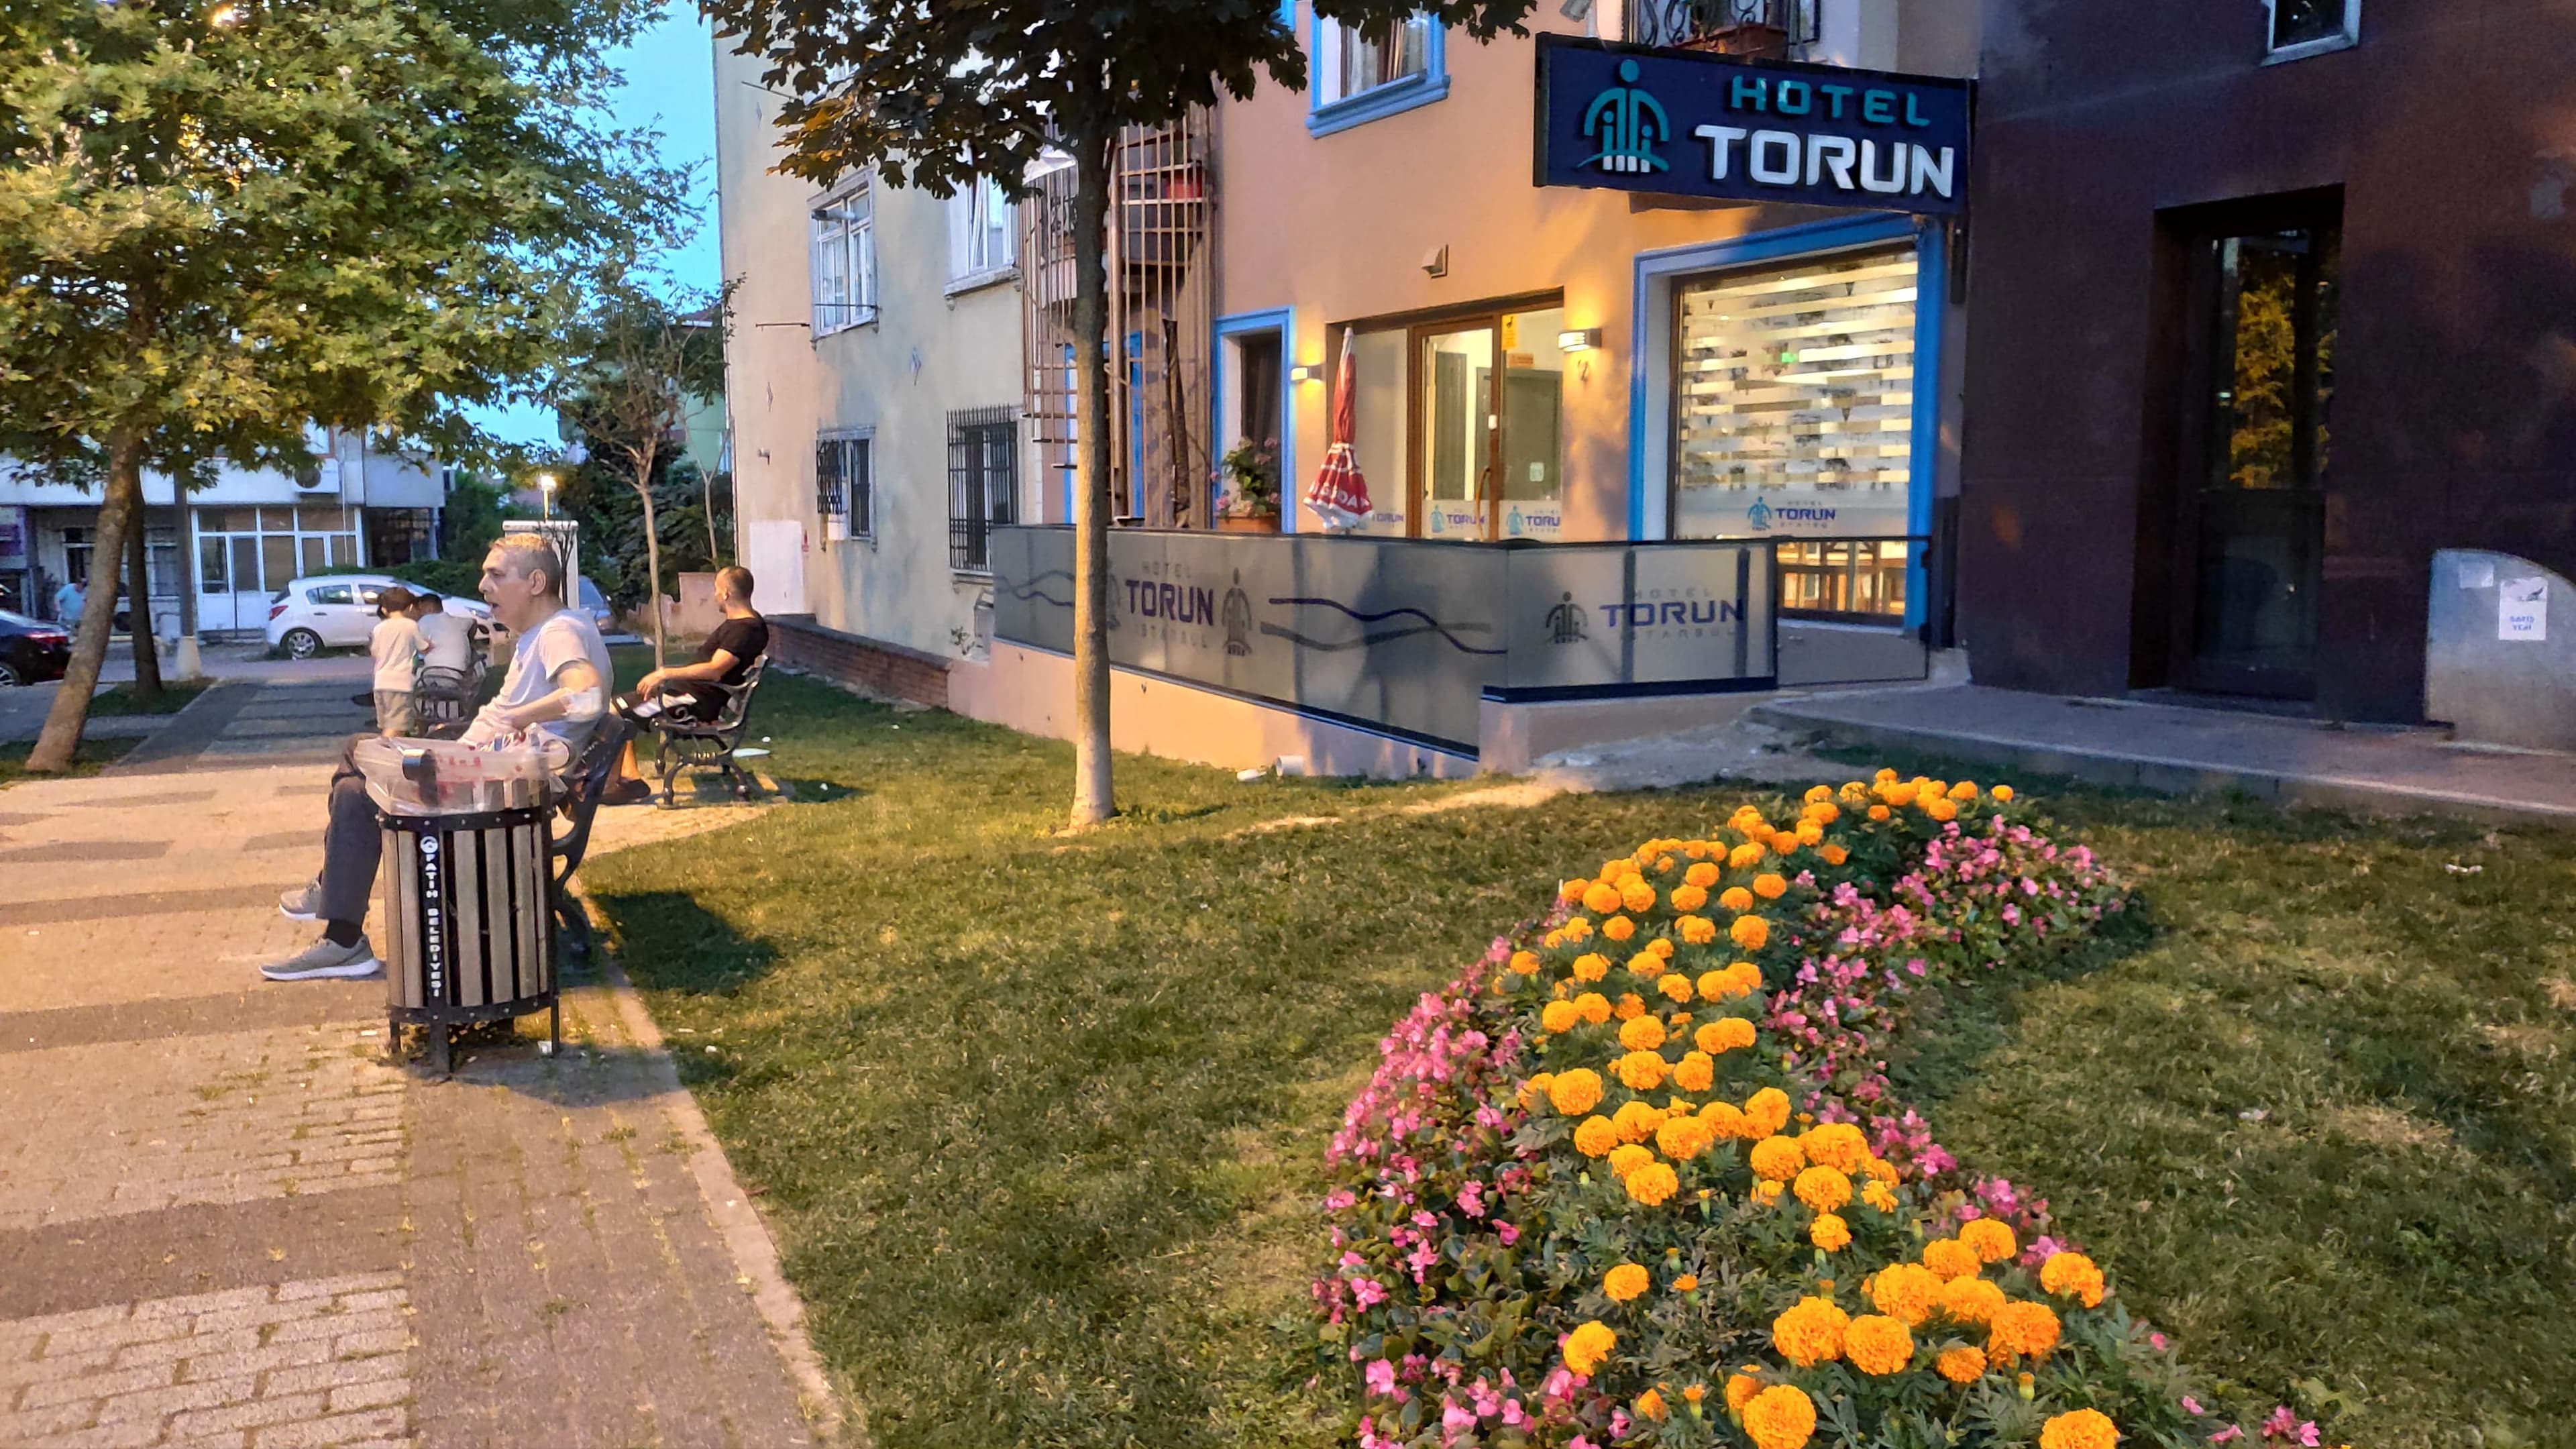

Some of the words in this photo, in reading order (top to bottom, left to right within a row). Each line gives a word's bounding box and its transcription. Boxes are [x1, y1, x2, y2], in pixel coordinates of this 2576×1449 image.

[1731, 75, 1931, 125] HOTEL
[1695, 124, 1954, 197] TORUN
[1525, 515, 1561, 527] TORU
[1775, 508, 1837, 521] TORUN
[1125, 579, 1214, 626] TORUN
[1599, 598, 1744, 627] TORUN
